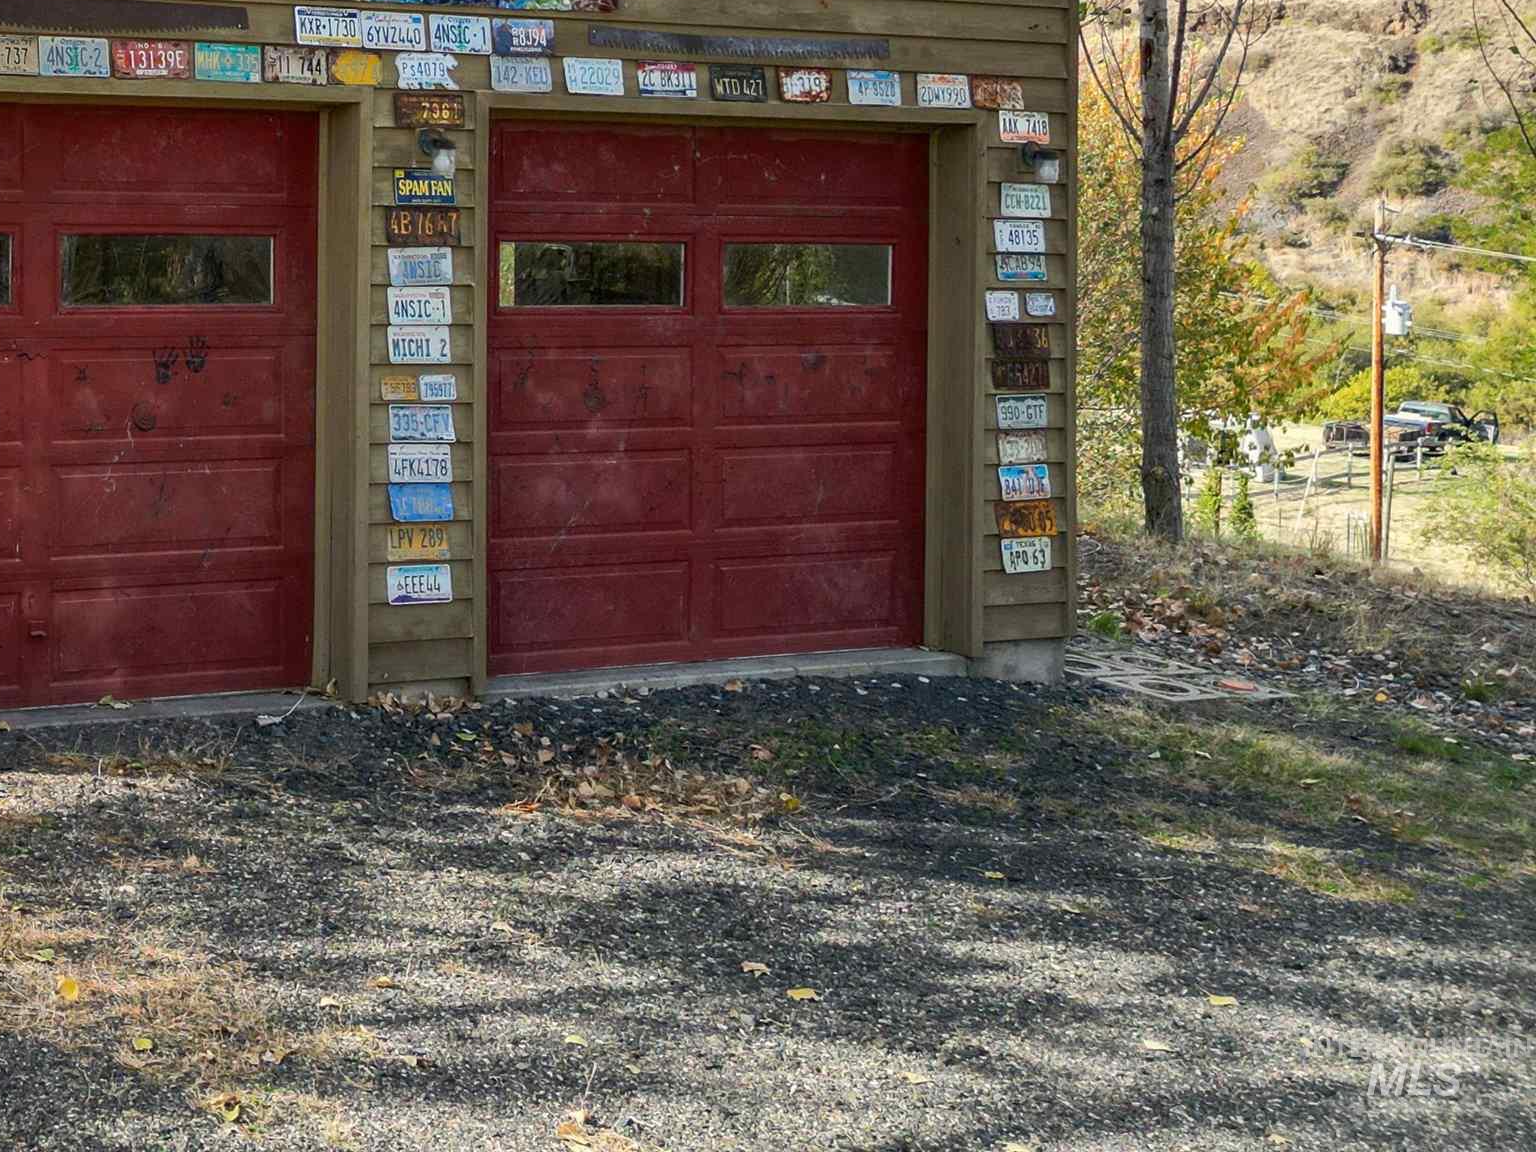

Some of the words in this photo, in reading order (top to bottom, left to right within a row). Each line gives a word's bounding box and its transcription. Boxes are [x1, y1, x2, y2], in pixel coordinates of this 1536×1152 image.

[743, 78, 763, 97] 427
[398, 179, 429, 196] SPAM
[431, 180, 452, 197] FAN
[1008, 229, 1039, 246] 48135
[392, 337, 432, 358] MICHI
[440, 338, 448, 357] 2
[394, 458, 448, 477] 4FK4178
[420, 527, 444, 548] 289
[404, 575, 441, 594] EEE44
